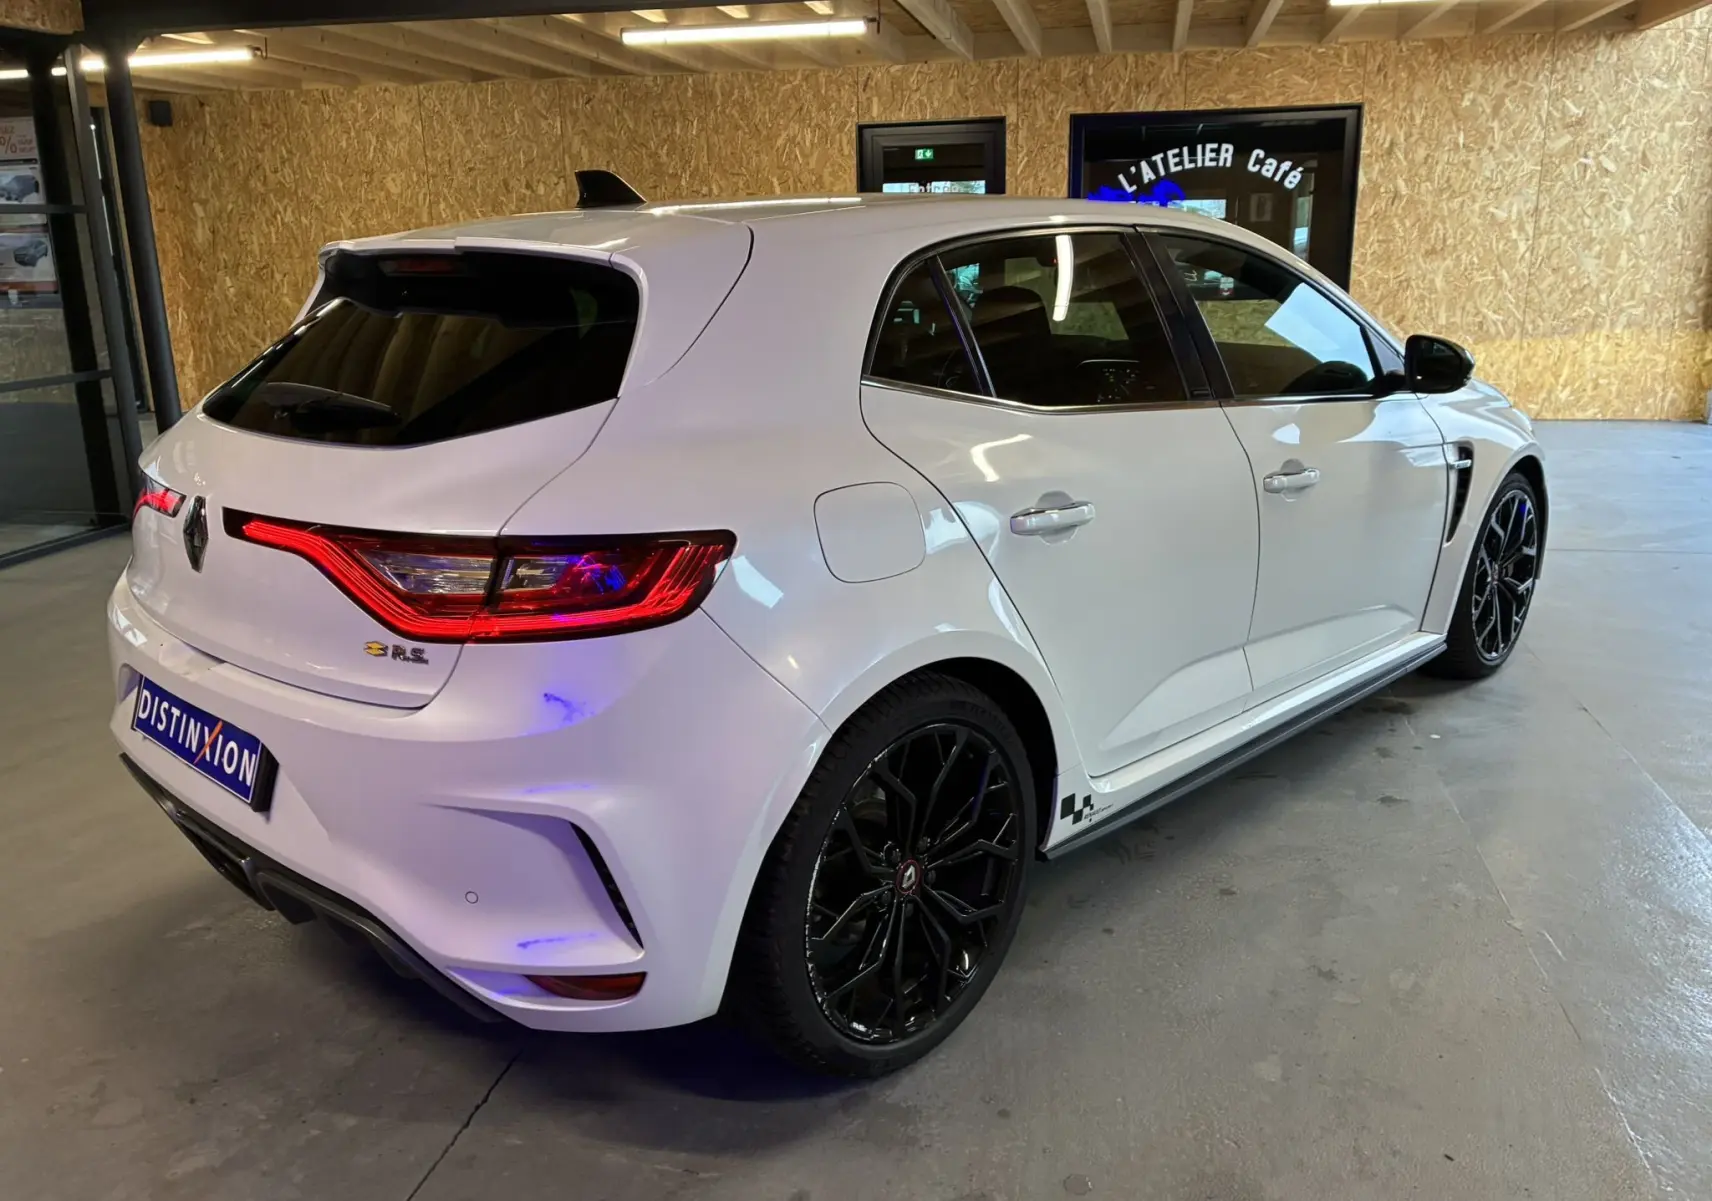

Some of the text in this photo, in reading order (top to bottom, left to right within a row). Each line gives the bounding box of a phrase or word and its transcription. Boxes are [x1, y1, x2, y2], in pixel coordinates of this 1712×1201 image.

[1118, 143, 1304, 194] L'ATELIER Café
[138, 689, 256, 787] DISTINXION
